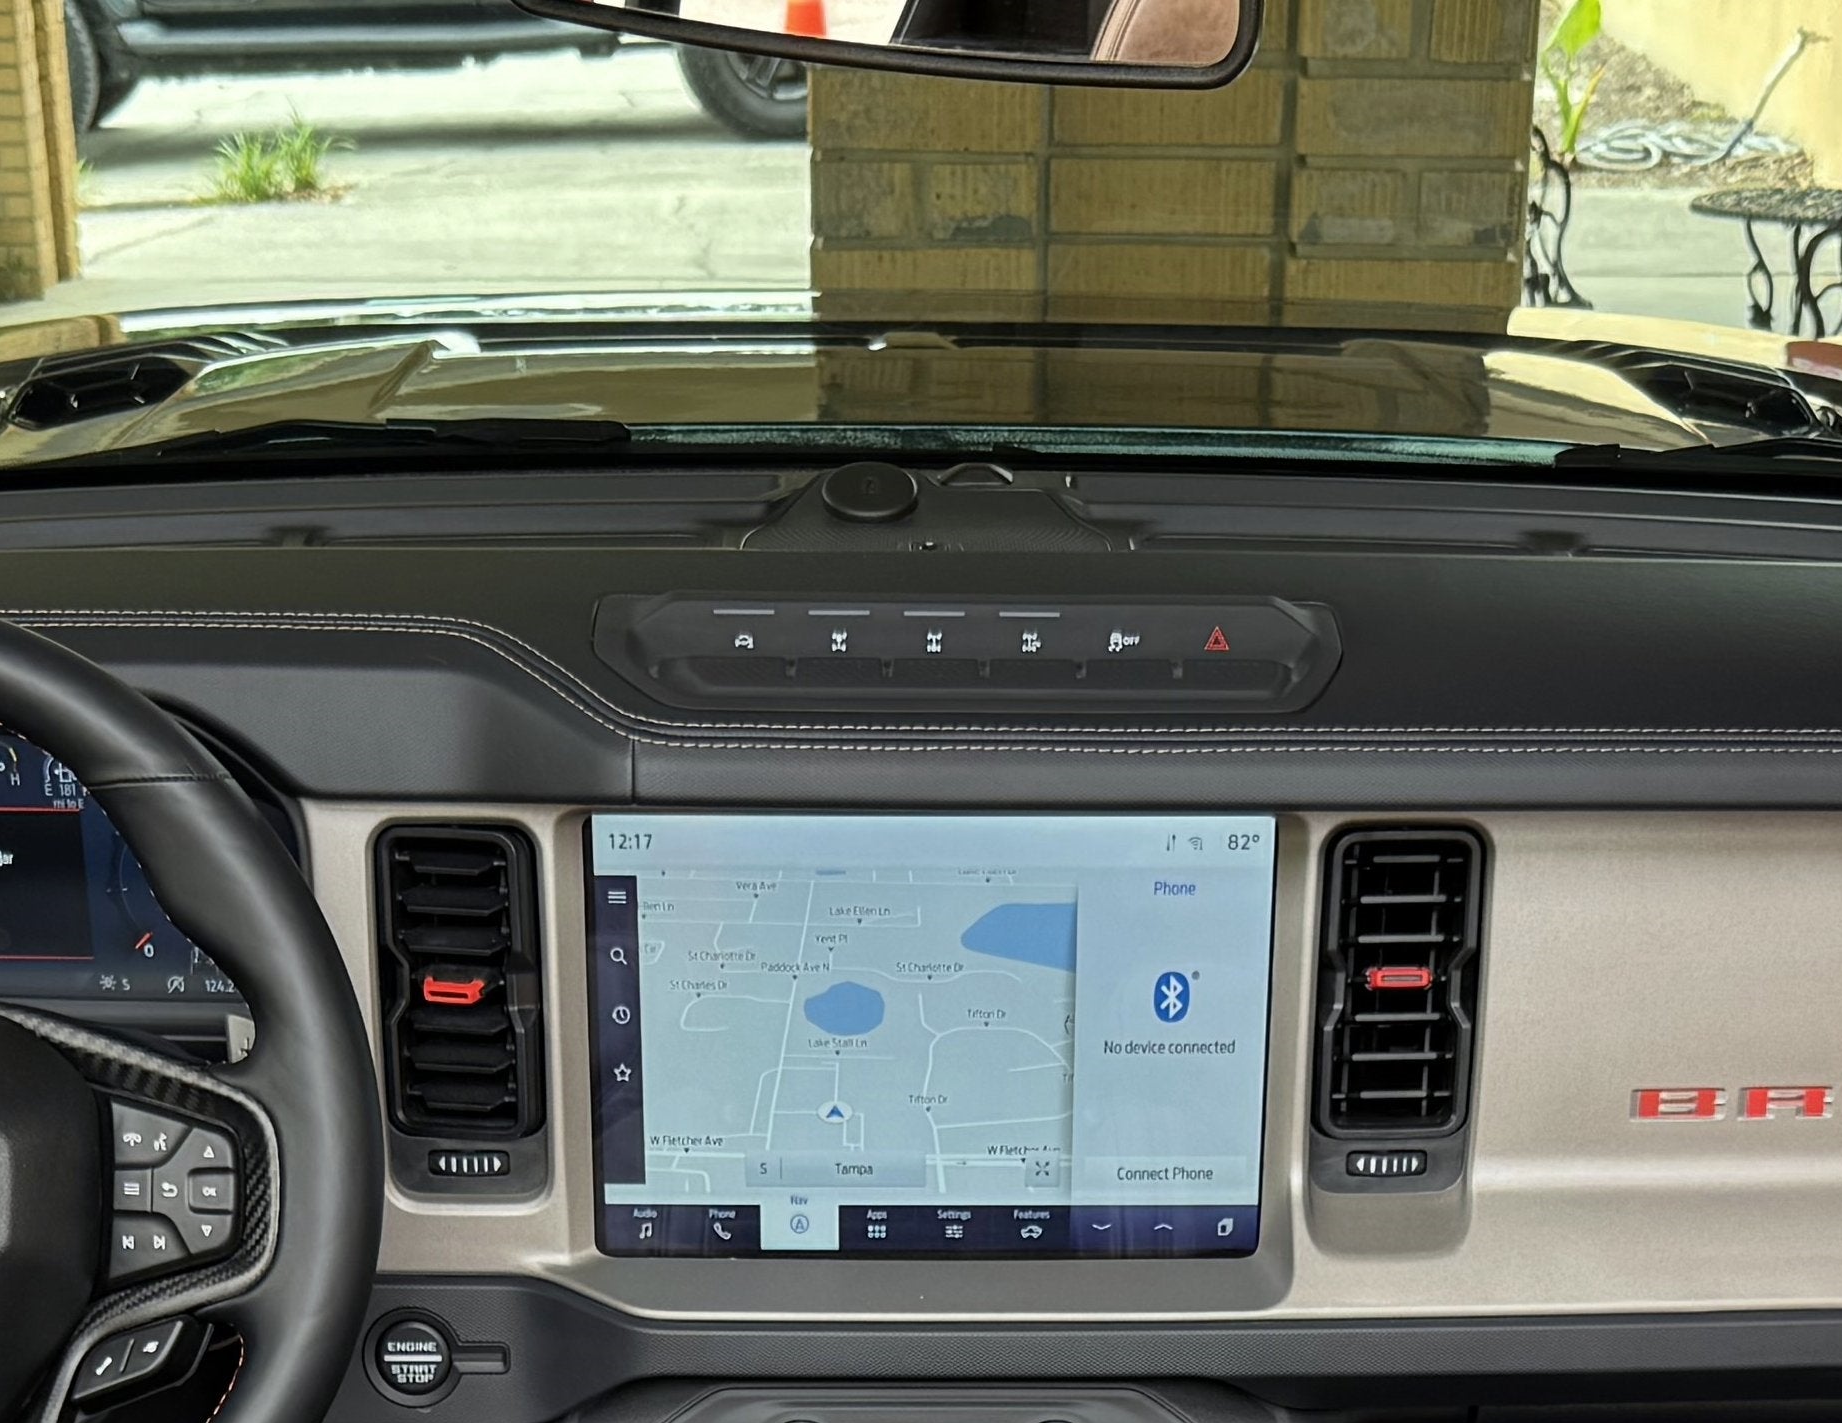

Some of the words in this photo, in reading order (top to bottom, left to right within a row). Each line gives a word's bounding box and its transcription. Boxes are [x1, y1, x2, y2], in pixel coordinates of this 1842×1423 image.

[1123, 636, 1140, 645] OFF
[10, 774, 20, 786] H
[59, 784, 77, 796] 181
[608, 834, 653, 850] 12:17
[1228, 834, 1261, 850] 82°
[736, 881, 758, 890] Vera
[759, 881, 777, 890] Ave
[1153, 881, 1197, 896] Phone
[829, 907, 851, 916] Lake
[853, 907, 877, 916] Ellen
[878, 907, 891, 916] Ln
[143, 943, 155, 957] 0
[688, 950, 698, 961] St
[699, 950, 743, 961] Charlotte
[745, 951, 756, 961] Dr
[761, 961, 800, 972] Paddock
[803, 961, 821, 972] Ave
[823, 961, 830, 972] N
[896, 962, 907, 972] St
[908, 962, 952, 972] Charlotte
[954, 962, 964, 972] Dr
[670, 980, 683, 990] St
[685, 980, 715, 990] Charles
[717, 980, 728, 990] Dr
[967, 1009, 995, 1019] Tifton
[997, 1009, 1007, 1019] Dr
[808, 1038, 834, 1048] Lake
[856, 1038, 867, 1048] Ln
[1103, 1040, 1122, 1054] No
[1124, 1040, 1165, 1054] device
[1168, 1040, 1236, 1054] connected
[909, 1094, 933, 1104] Tifton
[936, 1094, 948, 1104] Dr
[650, 1135, 660, 1145] W
[663, 1135, 702, 1146] Fletcher
[705, 1135, 724, 1146] Ave
[987, 1145, 998, 1155] W
[760, 1163, 768, 1175] S
[835, 1163, 874, 1176] Tampa
[1117, 1167, 1169, 1181] Connect
[1173, 1166, 1214, 1181] Phone
[202, 1186, 217, 1197] OK
[790, 1195, 808, 1205] Nav
[633, 1208, 658, 1219] Audio
[709, 1209, 736, 1219] Phone
[866, 1209, 888, 1221] Apps
[937, 1208, 972, 1221] Settings
[1013, 1208, 1050, 1220] Features
[387, 1341, 437, 1352] ENGINE
[391, 1364, 437, 1375] START
[397, 1373, 434, 1383] STOP
